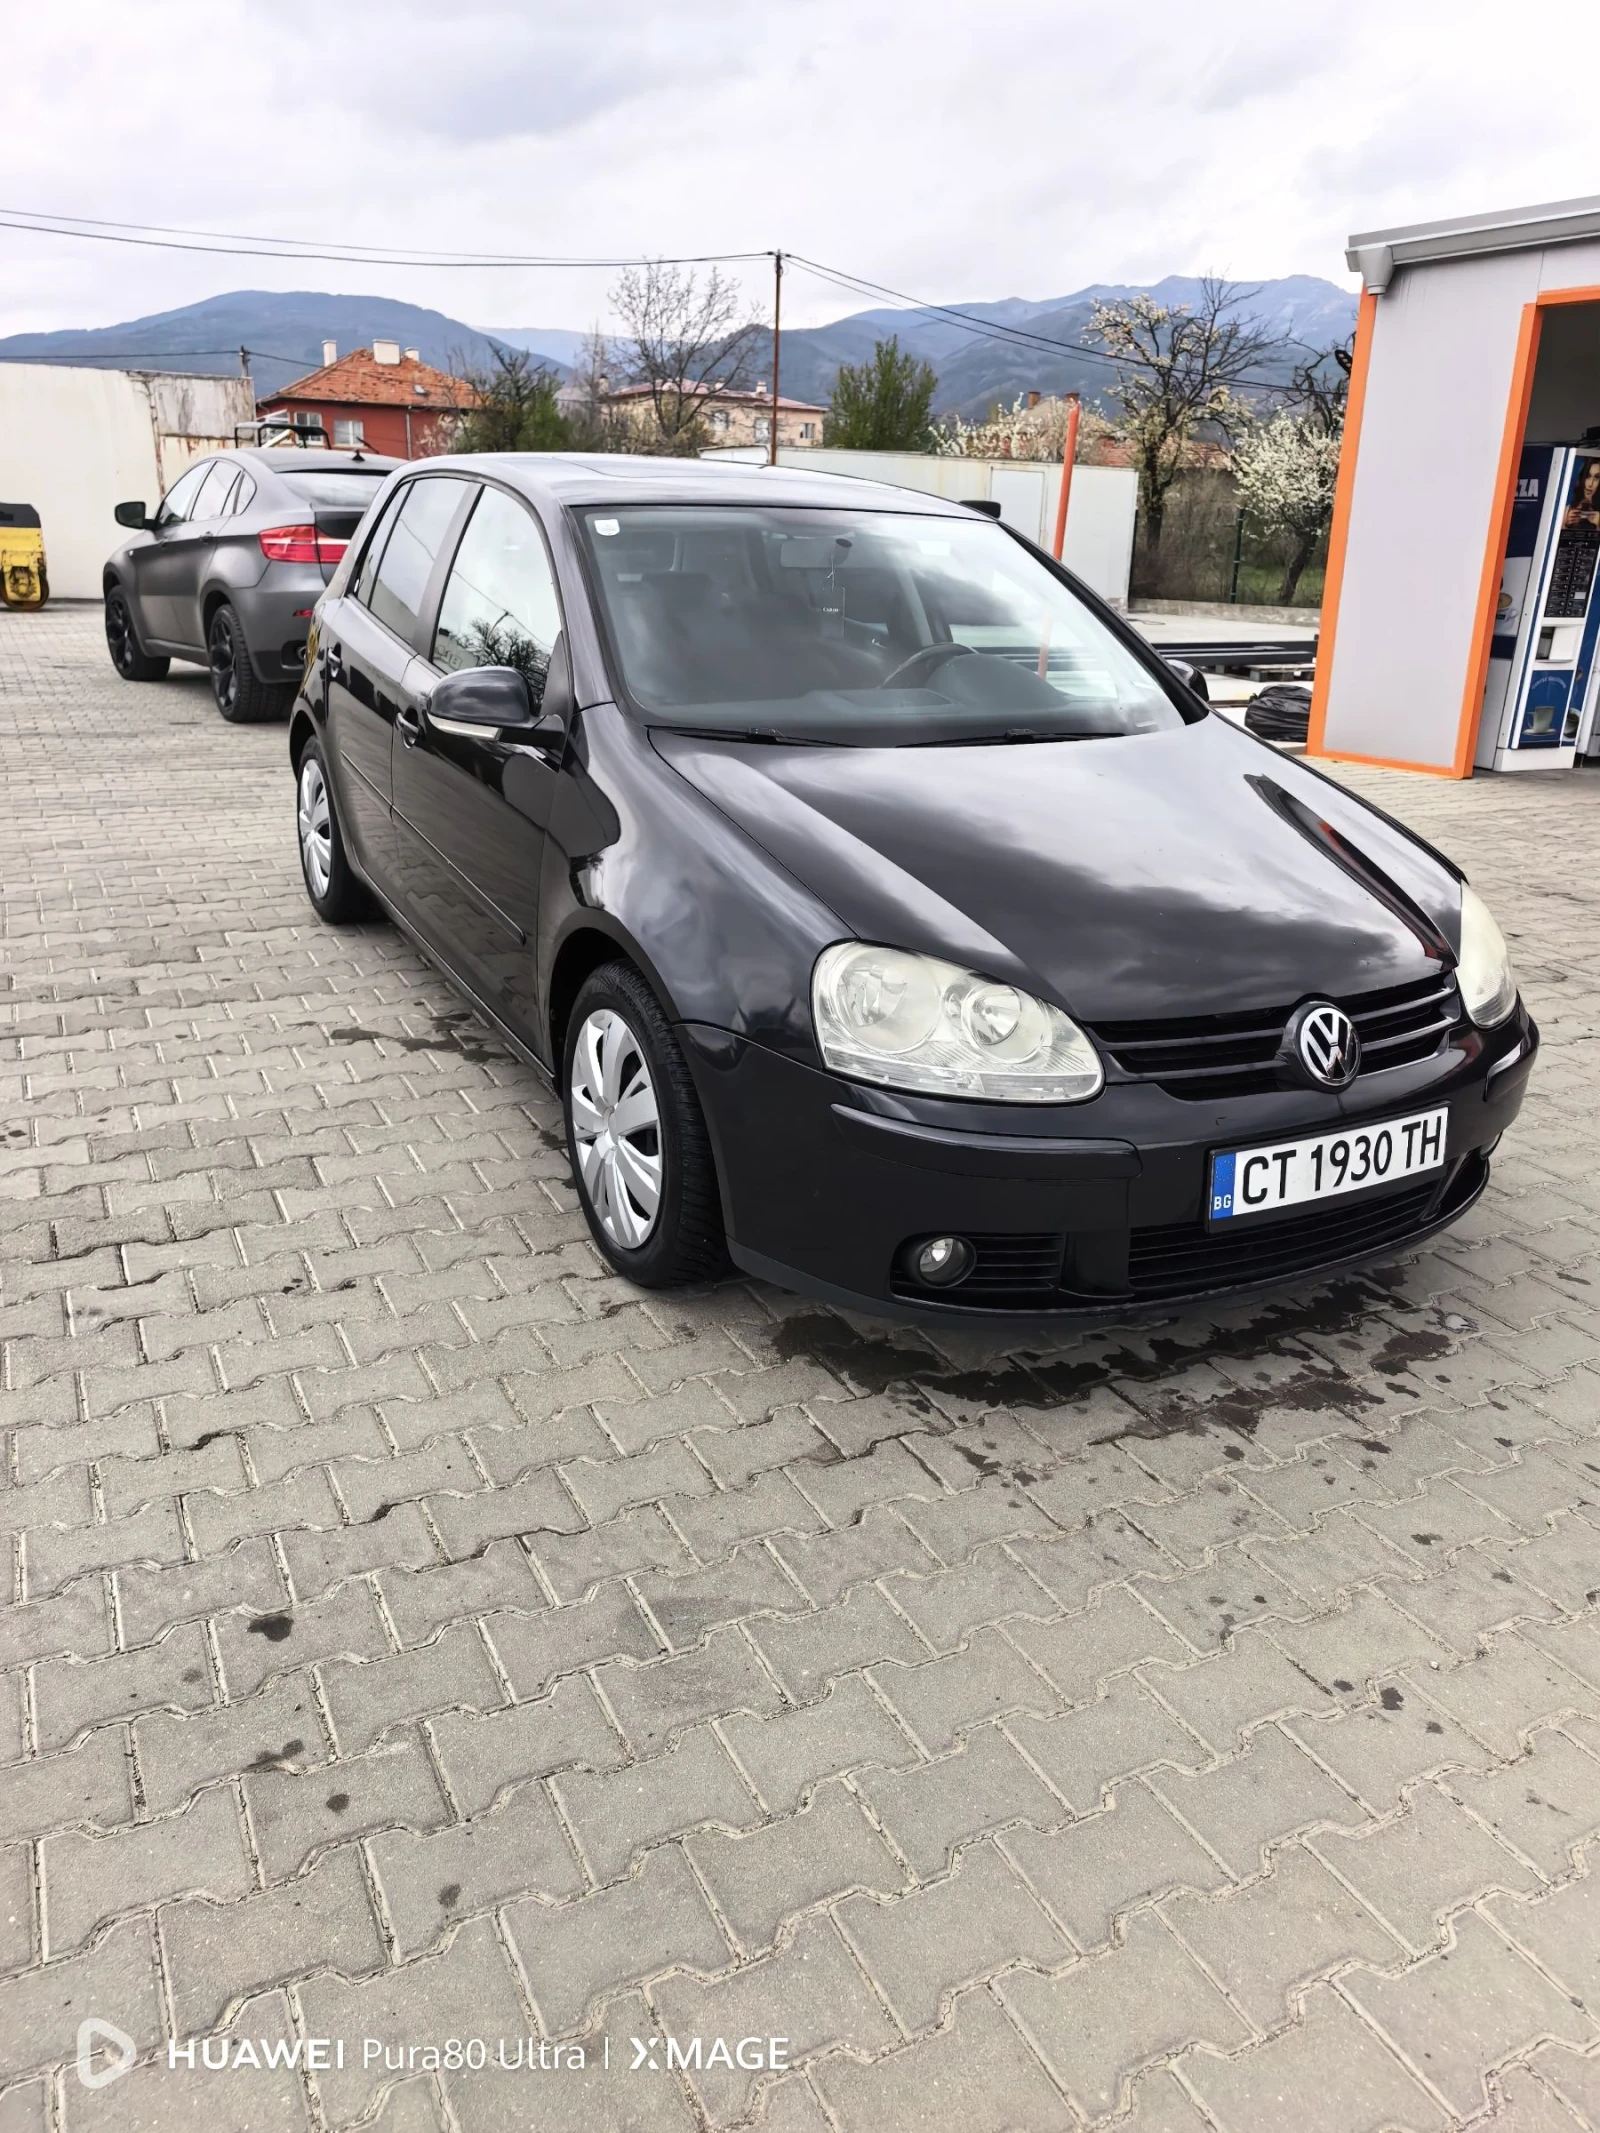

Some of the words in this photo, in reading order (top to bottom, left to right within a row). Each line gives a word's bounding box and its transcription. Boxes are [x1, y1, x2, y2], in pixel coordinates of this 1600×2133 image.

[1515, 478, 1539, 498] ZA
[1300, 1007, 1361, 1086] VW
[1242, 1149, 1297, 1205] CT
[1310, 1129, 1393, 1192] 1930
[1401, 1115, 1442, 1169] TH
[1213, 1194, 1232, 1211] BG
